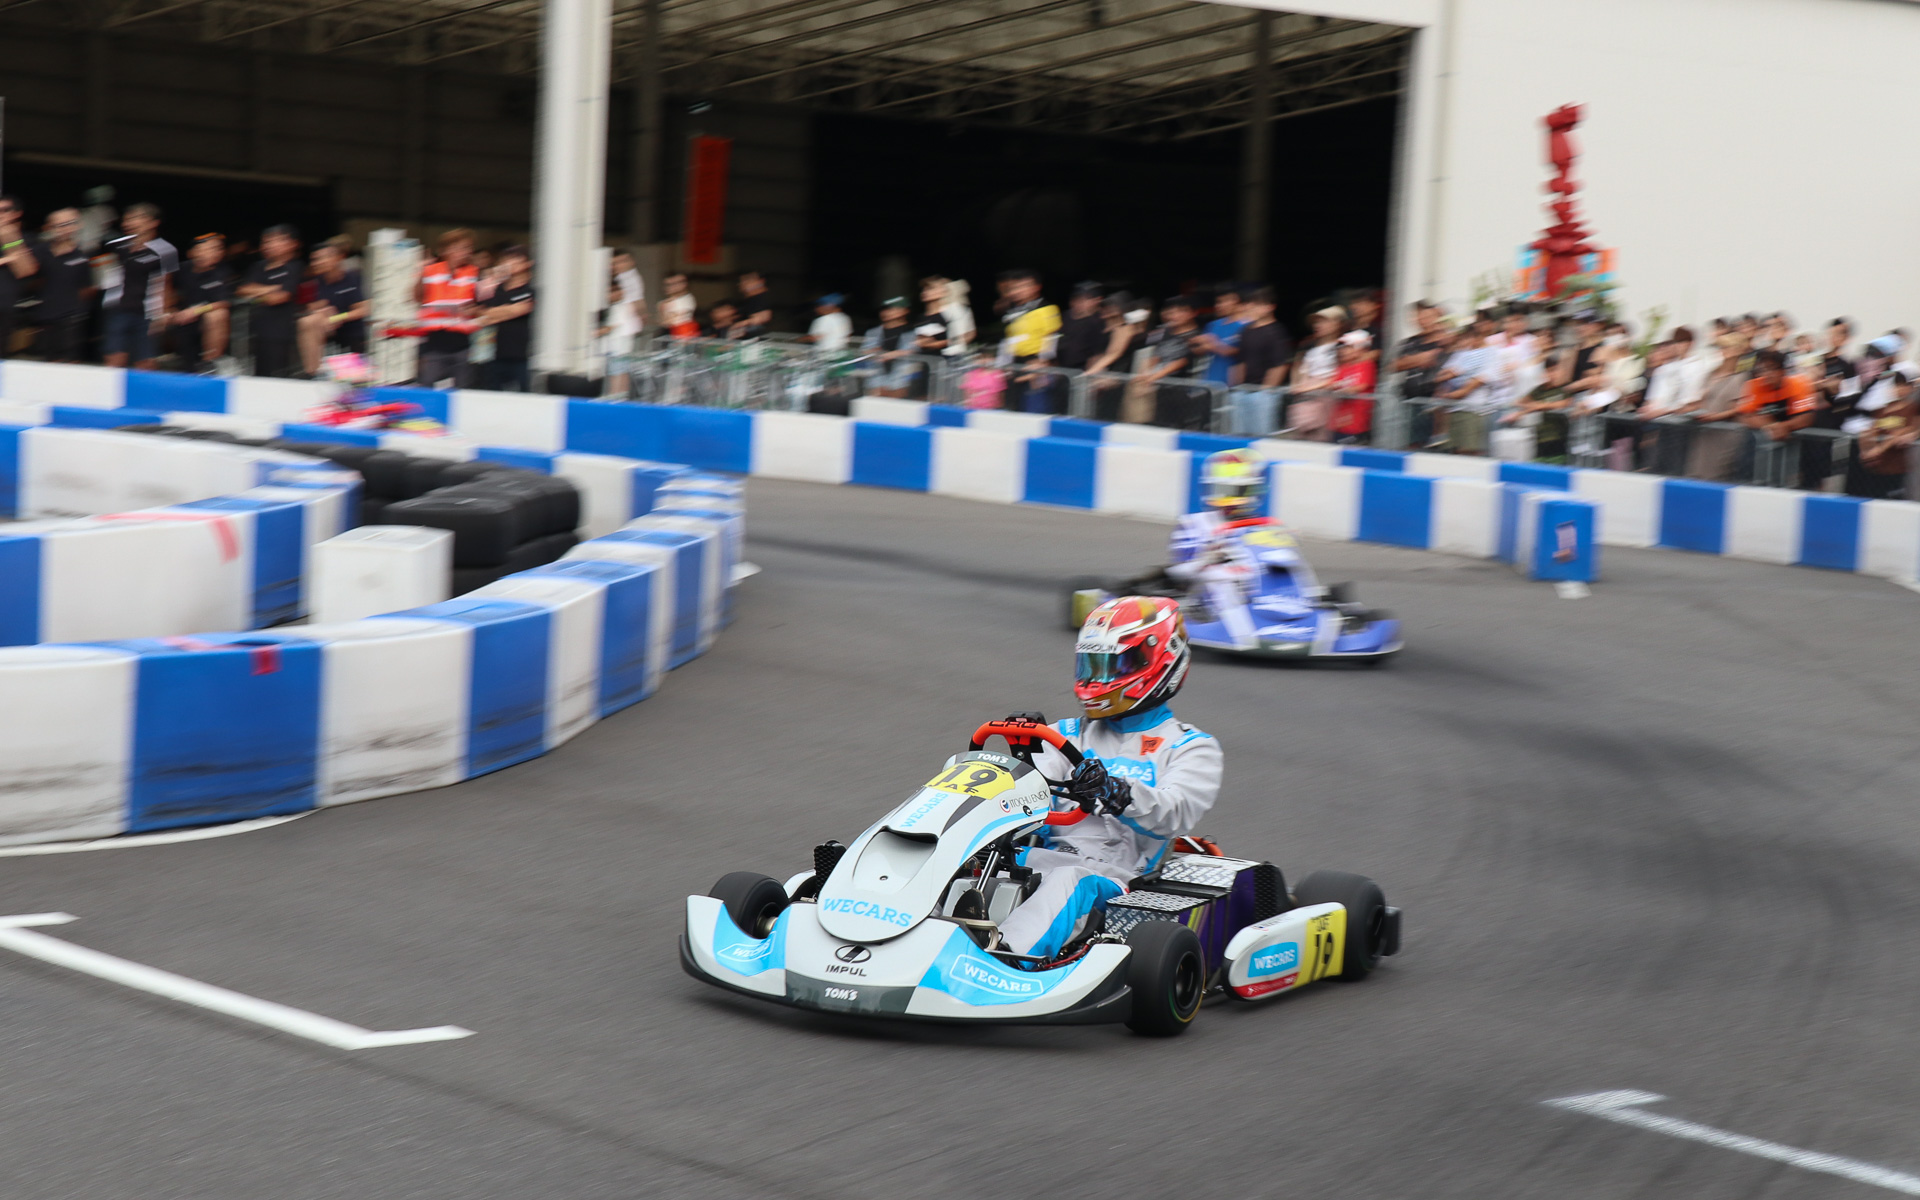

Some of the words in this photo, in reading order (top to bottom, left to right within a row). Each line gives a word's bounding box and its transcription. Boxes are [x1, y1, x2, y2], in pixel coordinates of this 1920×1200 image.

[938, 765, 998, 788] 19
[900, 792, 949, 828] WECARS
[1009, 795, 1033, 808] ITOCHU
[1030, 790, 1049, 803] ENEX
[823, 898, 912, 927] WECARS
[825, 964, 867, 977] IMPUL
[1253, 949, 1297, 970] WECARS
[964, 962, 1032, 992] WECARS
[825, 987, 859, 1001] TOM'S
